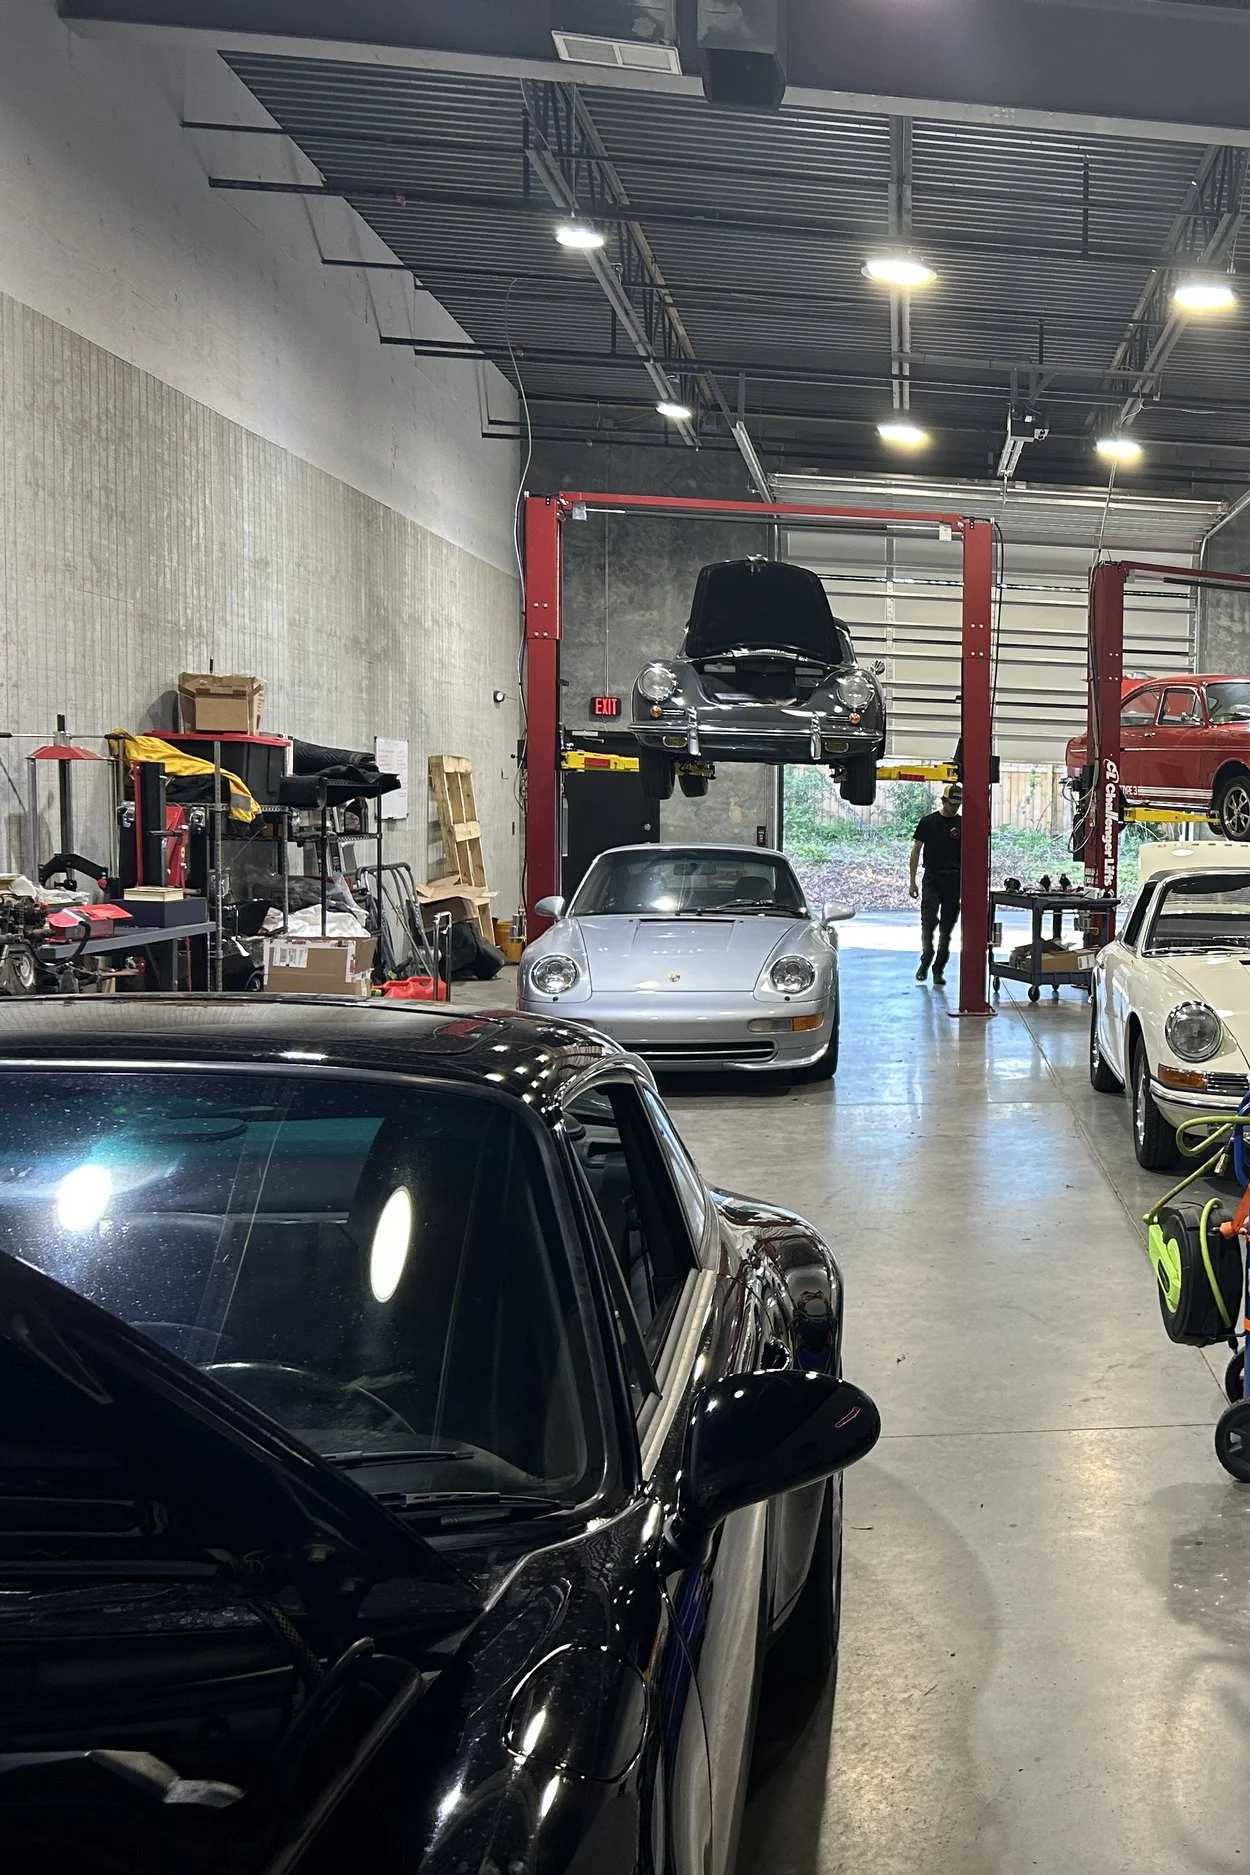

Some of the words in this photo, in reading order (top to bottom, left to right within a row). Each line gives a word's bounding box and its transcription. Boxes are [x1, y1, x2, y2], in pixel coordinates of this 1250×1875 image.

[595, 698, 617, 715] EXIT
[1102, 783, 1119, 857] Challenger
[1104, 859, 1115, 887] Lifts
